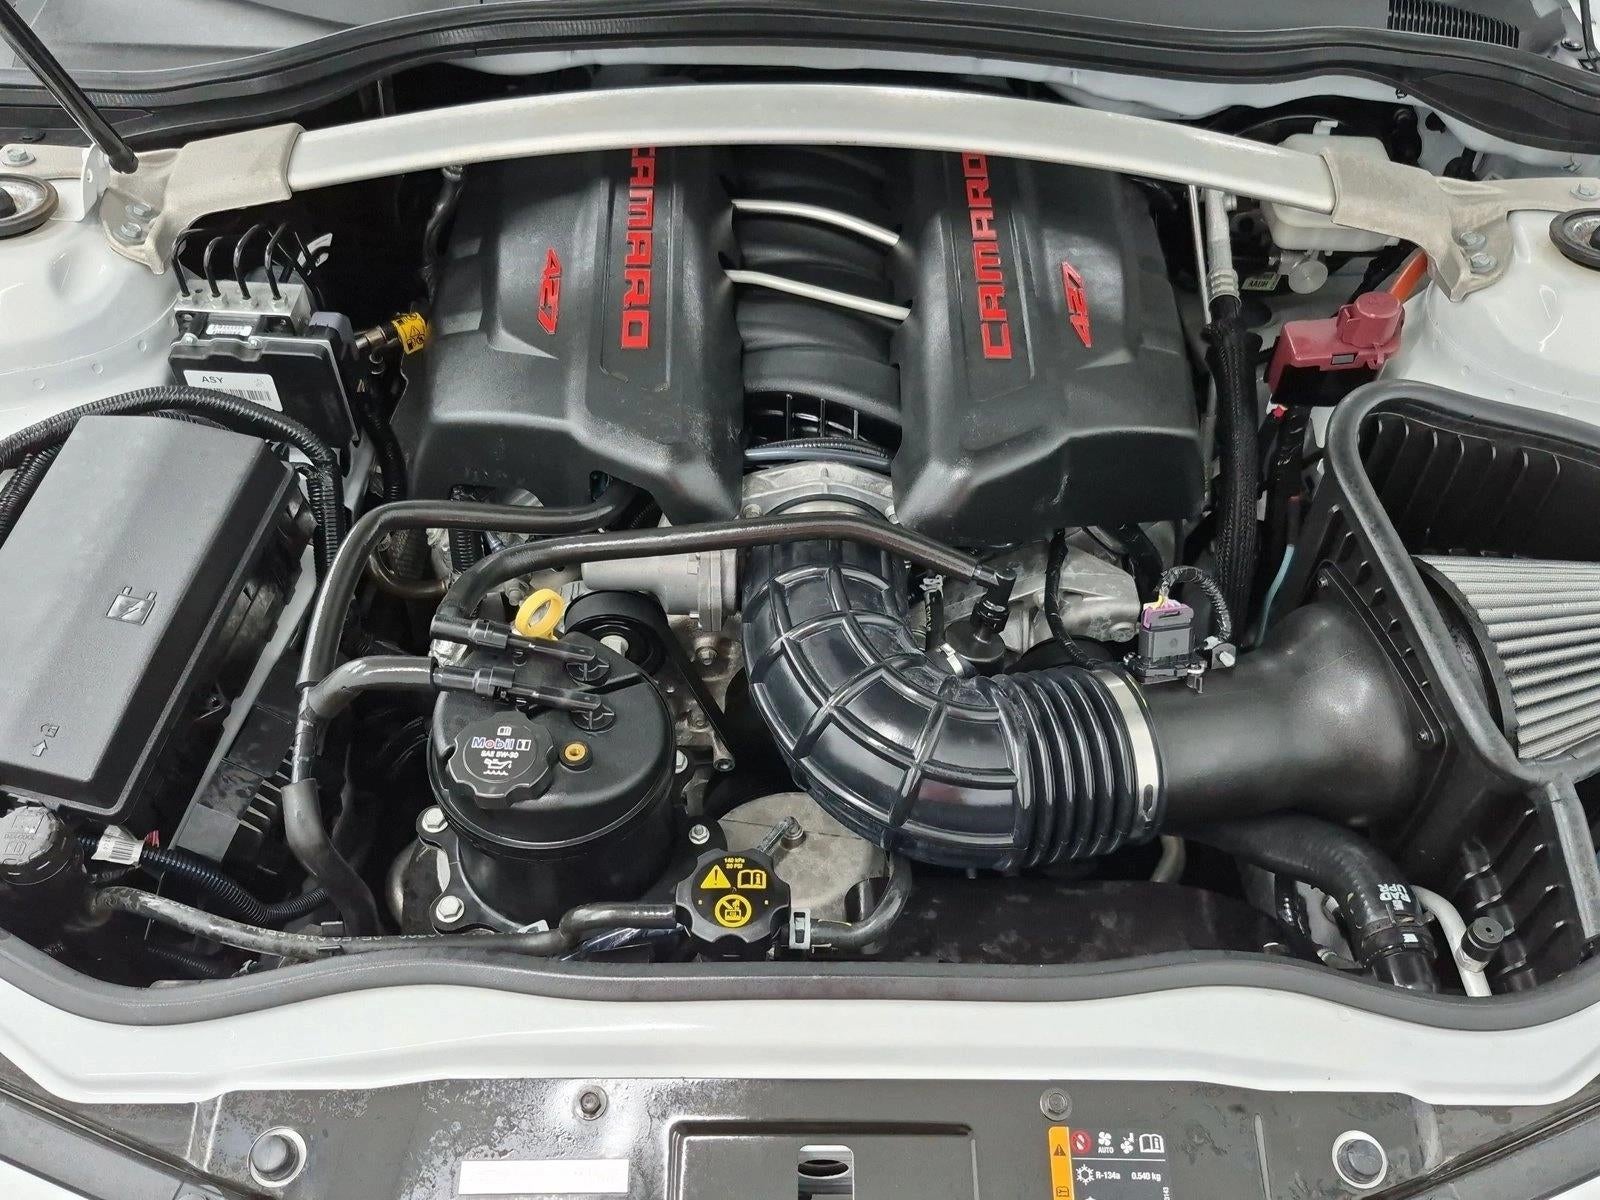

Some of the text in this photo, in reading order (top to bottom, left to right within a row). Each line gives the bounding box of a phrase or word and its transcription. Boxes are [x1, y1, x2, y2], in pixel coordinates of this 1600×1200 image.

[961, 152, 1012, 359] CAMARO
[537, 246, 562, 335] 427
[1061, 260, 1092, 349] 427
[471, 736, 515, 750] Mobil
[481, 750, 519, 759] SAE 5W-30
[1377, 883, 1407, 895] UPR
[1379, 891, 1411, 903] RAD
[1098, 1146, 1114, 1154] AUTO
[1095, 1171, 1120, 1180] R-134a
[1131, 1171, 1161, 1181] 0.540 kg
